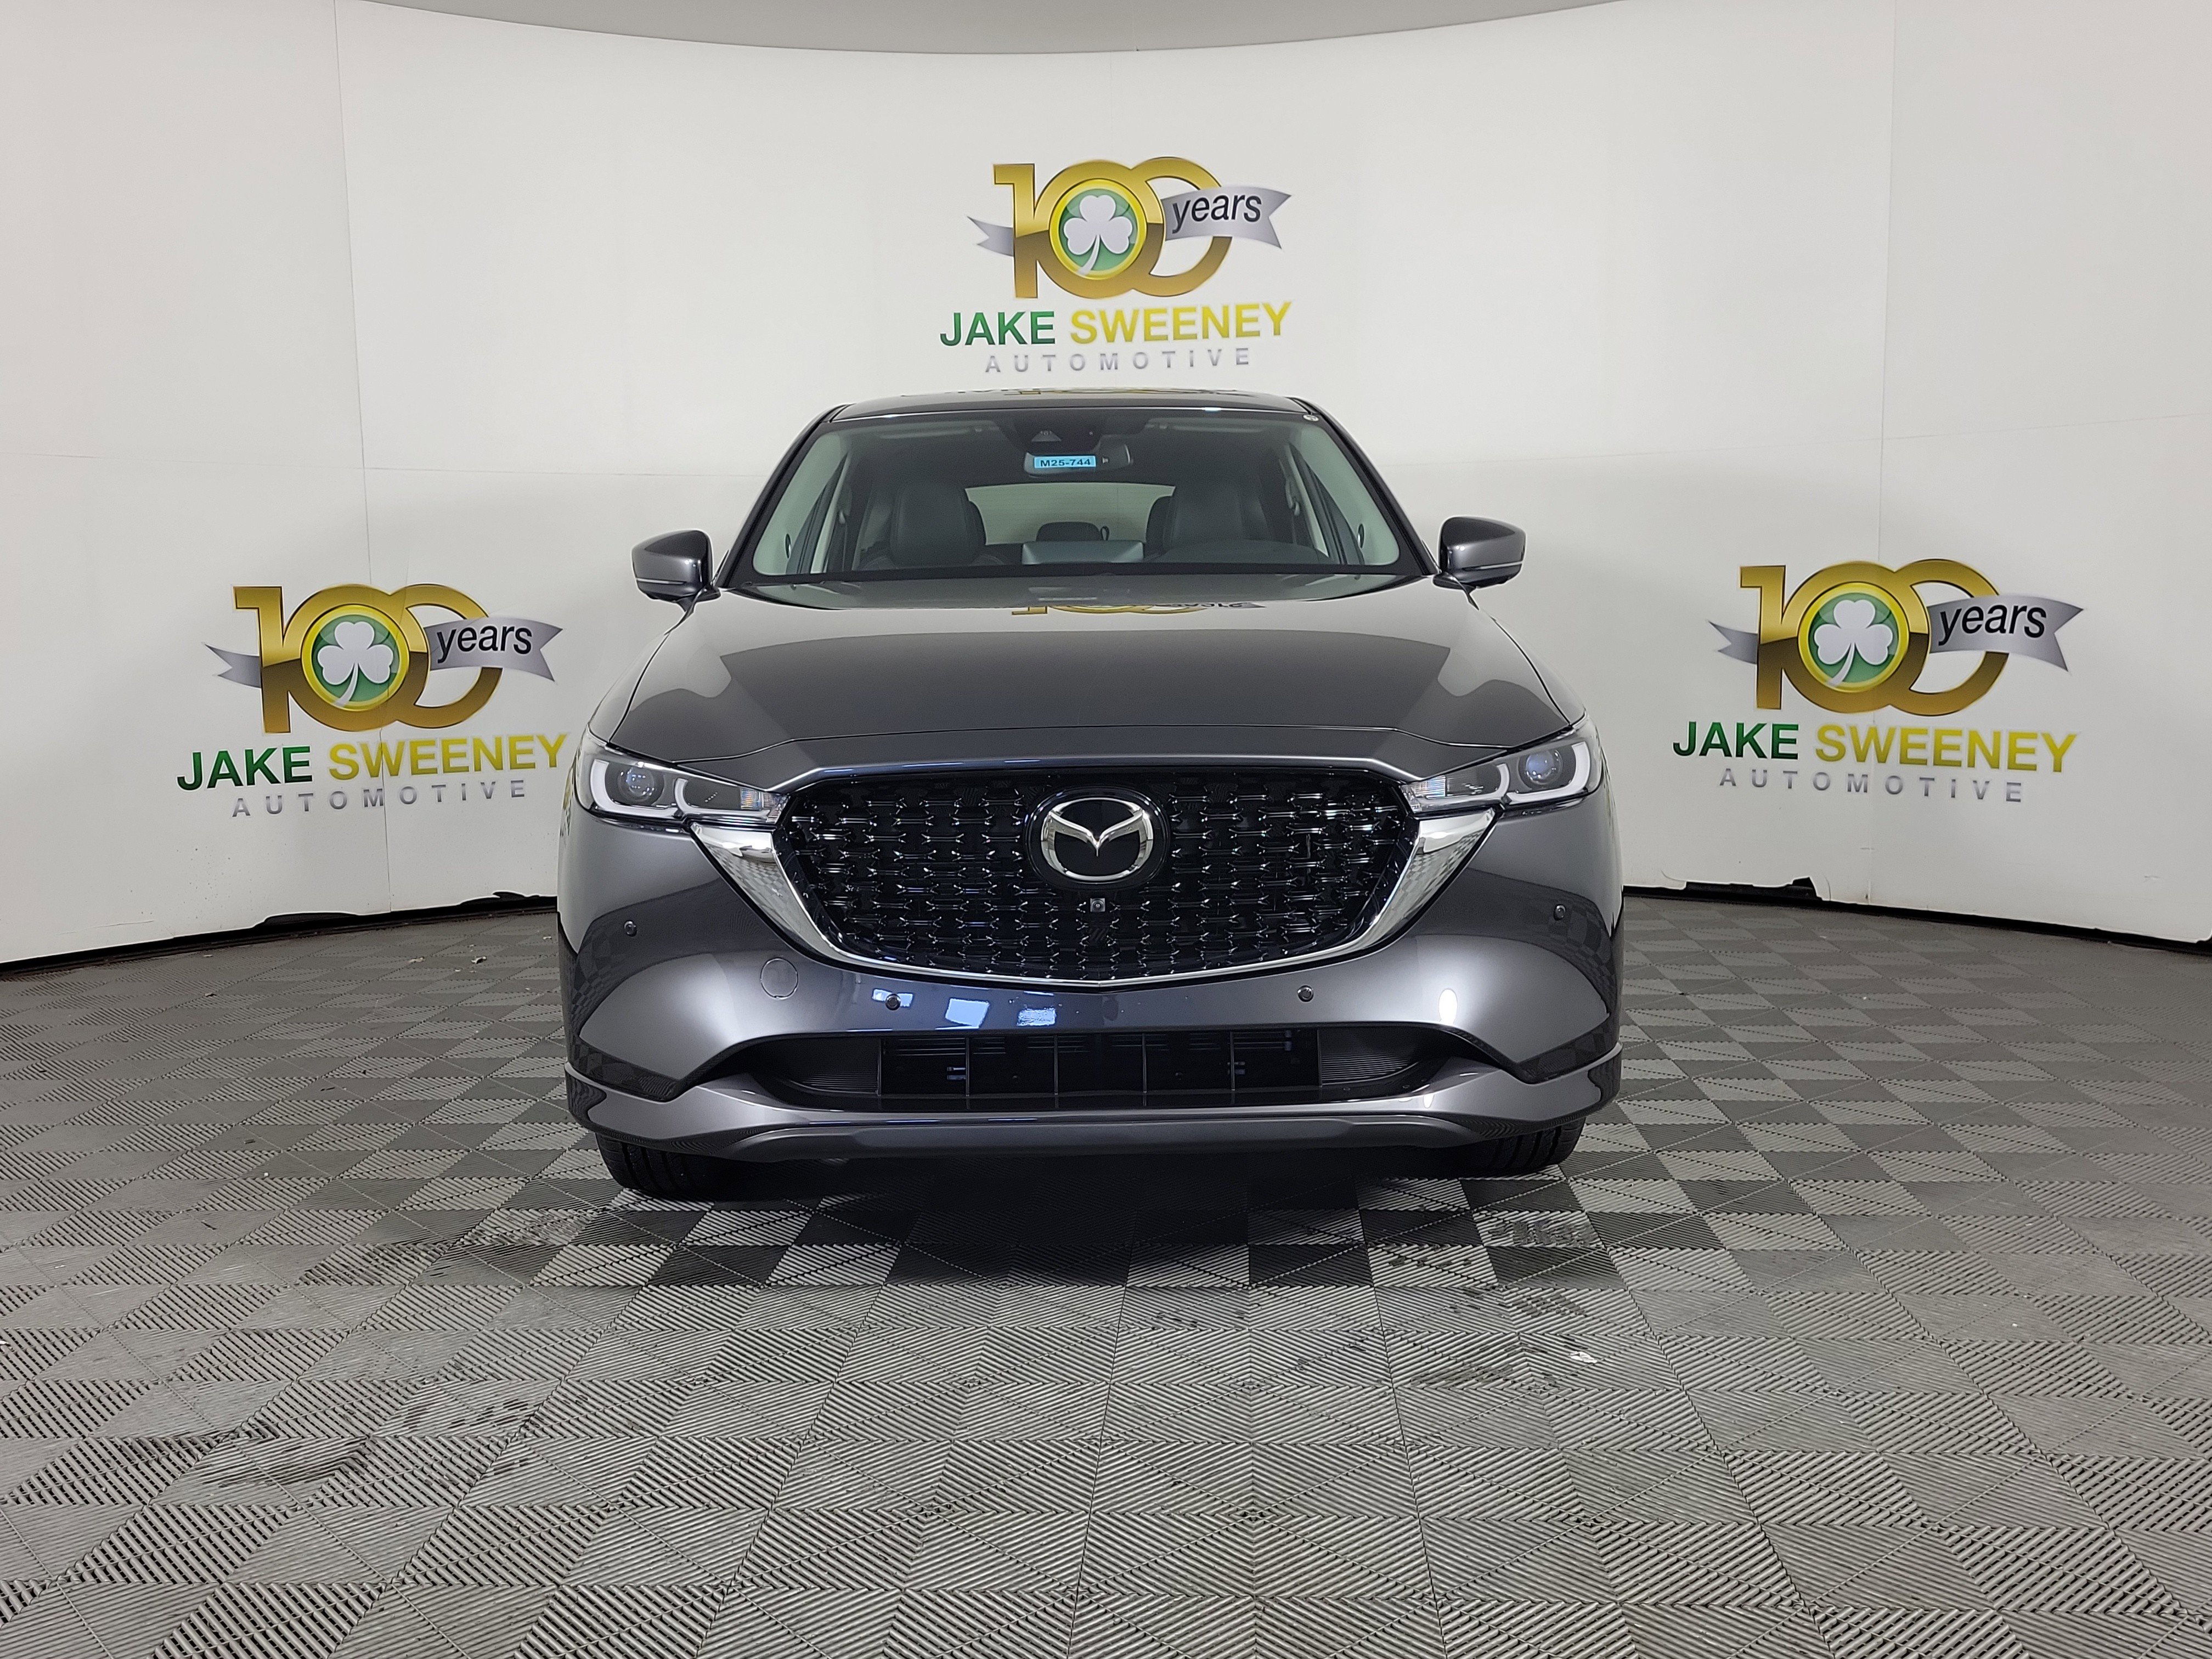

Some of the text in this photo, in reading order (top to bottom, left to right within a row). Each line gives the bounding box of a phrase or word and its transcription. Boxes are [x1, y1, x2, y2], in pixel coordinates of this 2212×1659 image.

[993, 156, 1263, 299] 100 years
[940, 302, 1293, 347] JAKE SWEENEY
[985, 347, 1250, 373] AUTOMOTIVE
[1040, 458, 1091, 467] M25-744
[233, 583, 533, 734] 100 years
[1739, 558, 2047, 716] 100 years
[176, 733, 568, 792] JAKE SWEENEY
[1673, 721, 2078, 774] JAKE SWEENEY
[232, 780, 526, 818] AUTOMOTIVE
[1719, 768, 2022, 803] AUTOMOTIVE
